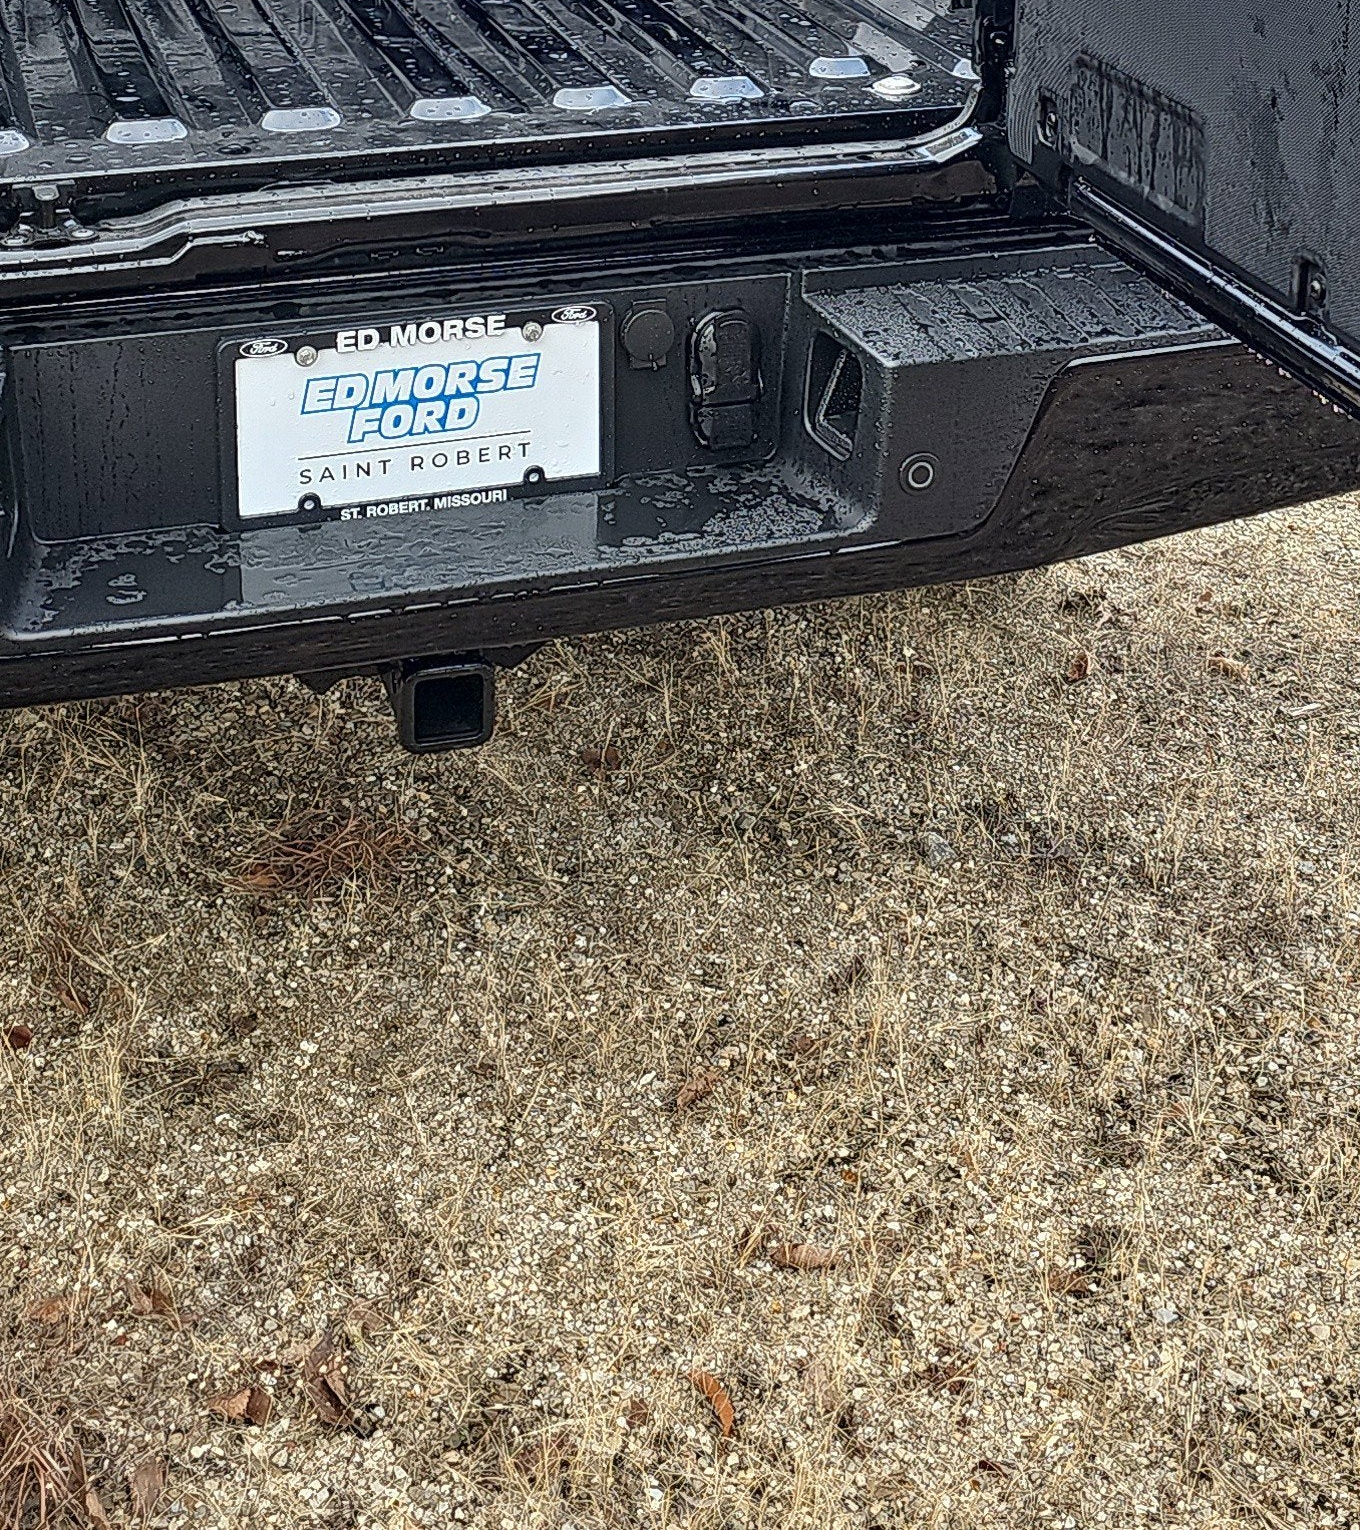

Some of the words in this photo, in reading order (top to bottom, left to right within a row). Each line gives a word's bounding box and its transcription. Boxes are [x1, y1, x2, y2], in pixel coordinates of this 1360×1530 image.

[336, 328, 381, 354] ED
[390, 314, 507, 348] MORSE
[300, 372, 371, 416] ED
[369, 353, 541, 408] MORSE
[346, 394, 480, 444] FORD
[299, 458, 392, 485] SAINT
[410, 442, 532, 471] ROBERT
[339, 508, 363, 521] ST.
[433, 488, 508, 510] MISSOURI
